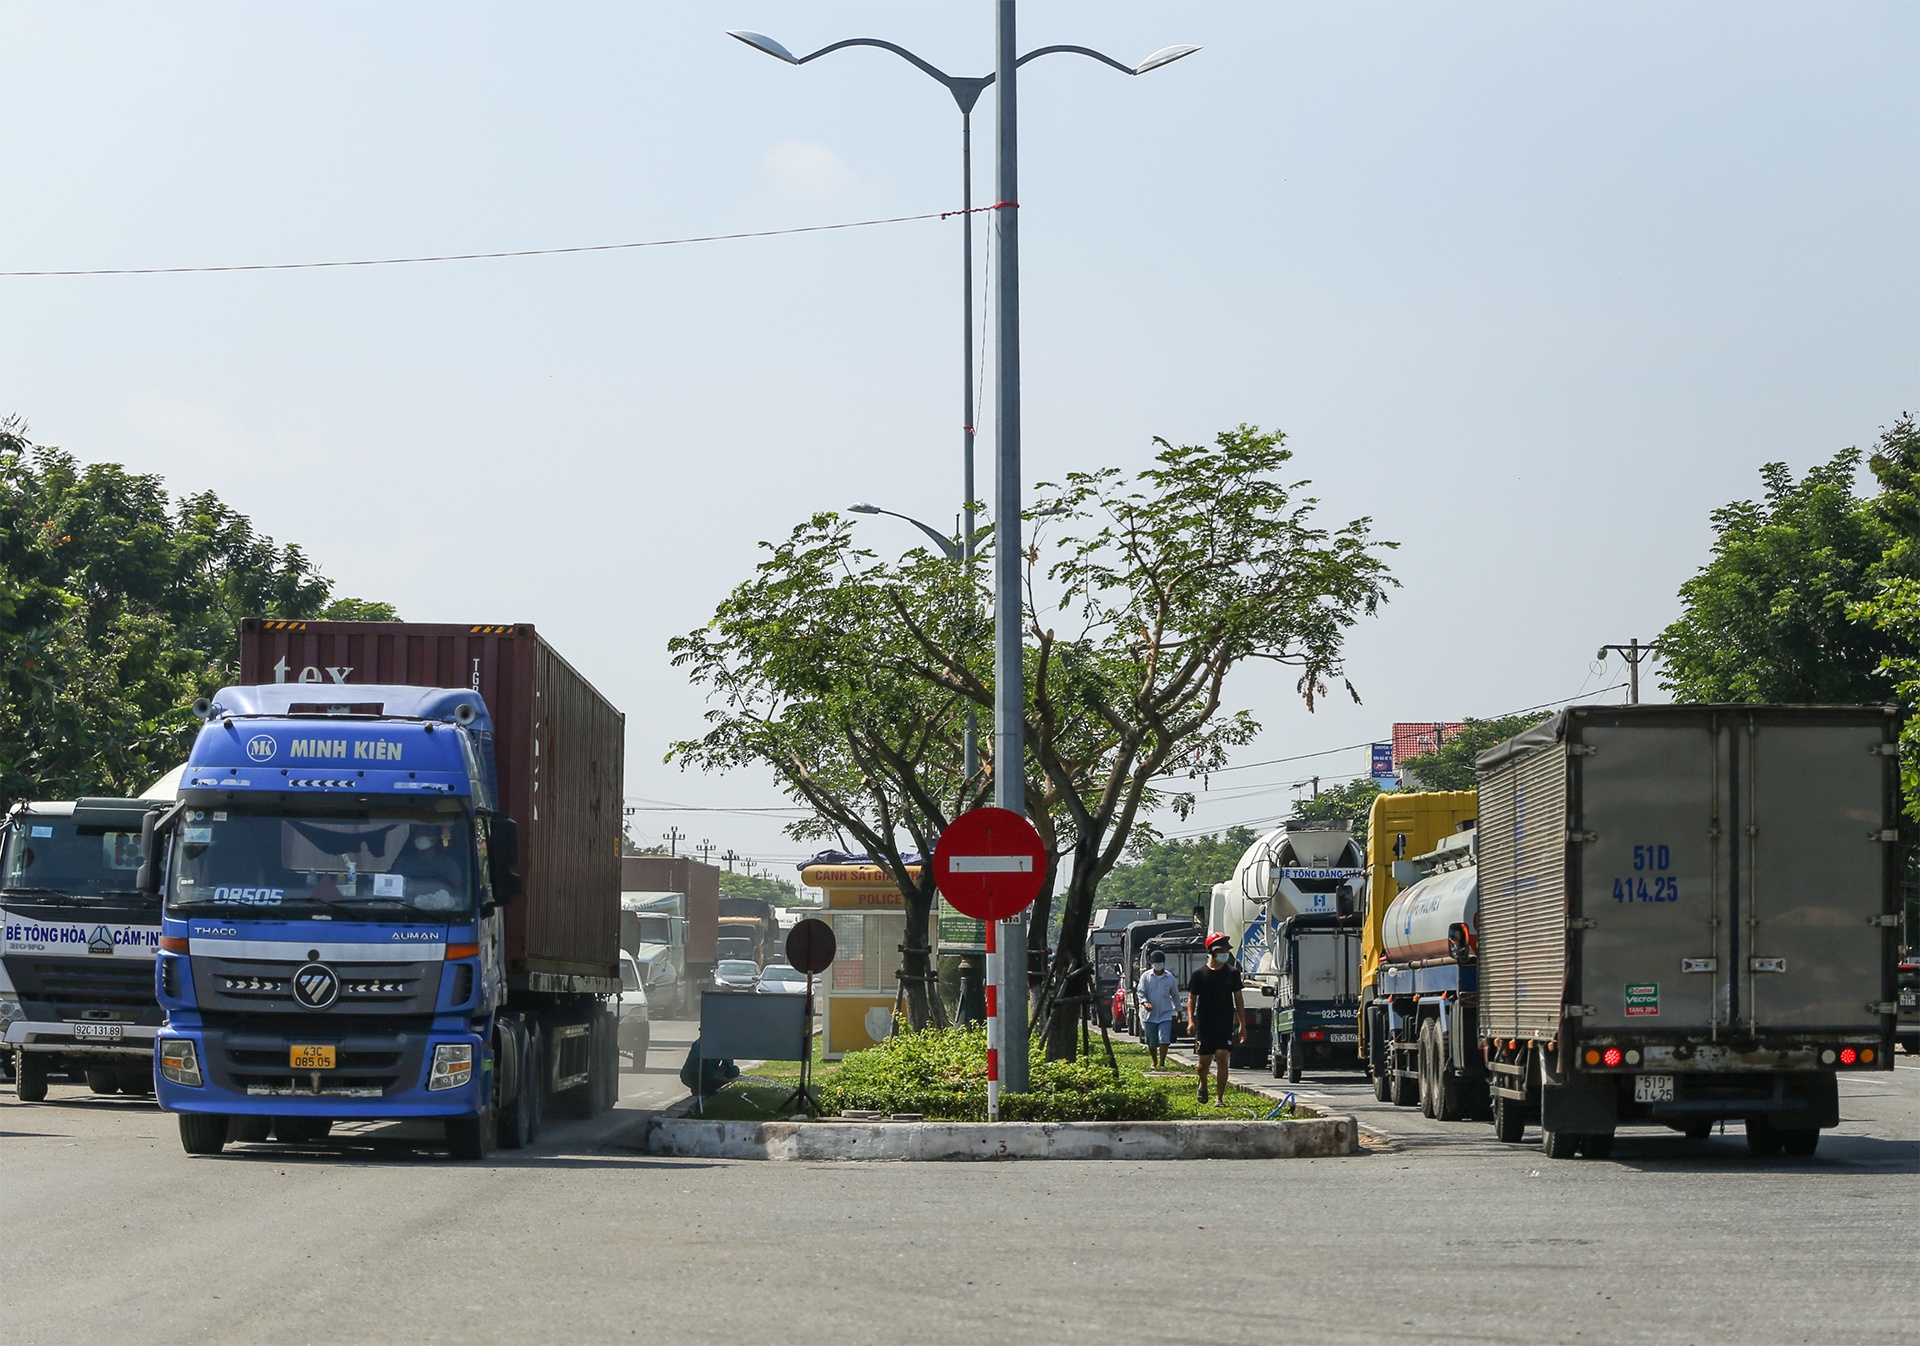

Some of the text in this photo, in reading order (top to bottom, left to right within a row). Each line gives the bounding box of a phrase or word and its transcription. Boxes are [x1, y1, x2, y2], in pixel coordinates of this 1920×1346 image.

[290, 738, 402, 761] MINH KIÊN
[1632, 845, 1670, 871] 51D
[1612, 876, 1678, 903] 414.25
[213, 887, 285, 906] 08505
[858, 894, 902, 905] POLICE
[6, 923, 162, 946] BÊ TÔNG HÒA CẦM-IN
[194, 927, 237, 936] THACO
[391, 932, 439, 940] AUMAN
[76, 1024, 120, 1036] 92C-131.89
[303, 1046, 323, 1056] 43C
[295, 1057, 331, 1067] 085.05
[1644, 1076, 1666, 1089] 51D
